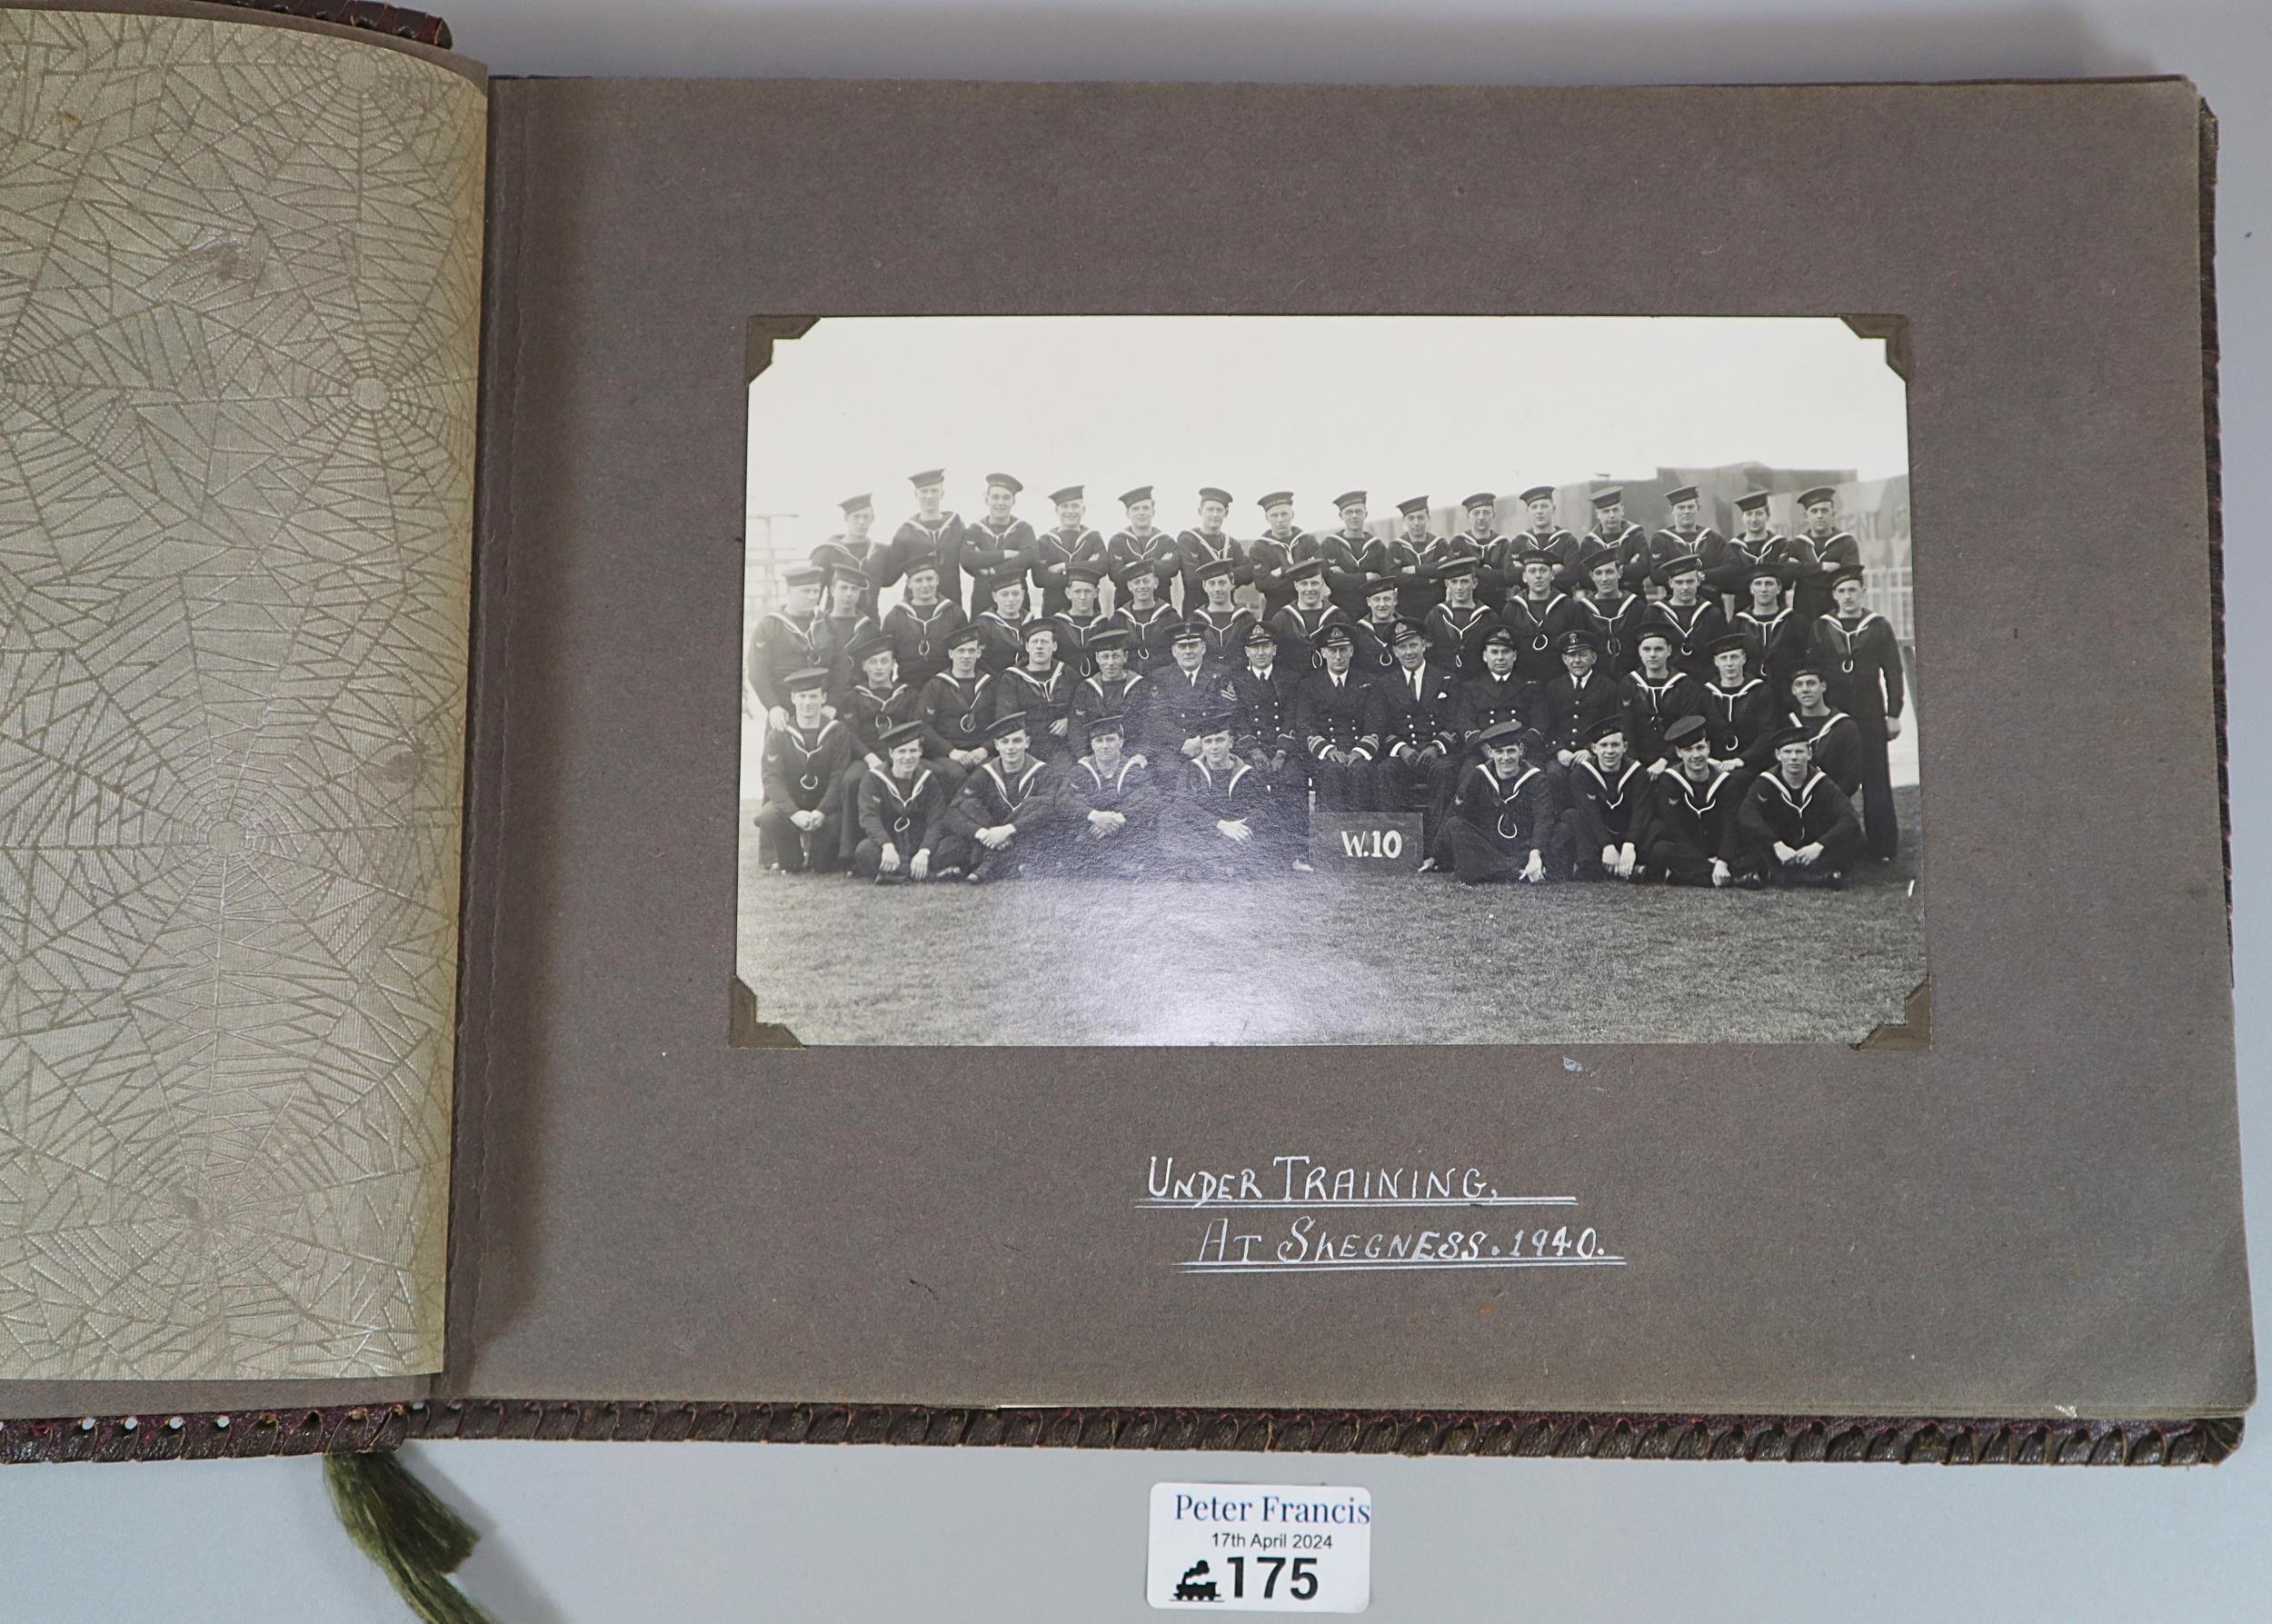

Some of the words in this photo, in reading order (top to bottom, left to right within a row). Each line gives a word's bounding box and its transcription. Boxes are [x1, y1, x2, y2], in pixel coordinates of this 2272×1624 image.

[1341, 830, 1402, 859] W.10
[1149, 1156, 1262, 1205] UNDER
[1199, 1218, 1262, 1262] AT
[1175, 1494, 1252, 1522] Peter
[1262, 1496, 1370, 1525] Francis
[1211, 1532, 1246, 1548] 17th
[1251, 1533, 1287, 1551] April
[1293, 1534, 1333, 1549] 2024
[1226, 1556, 1319, 1600] 175
